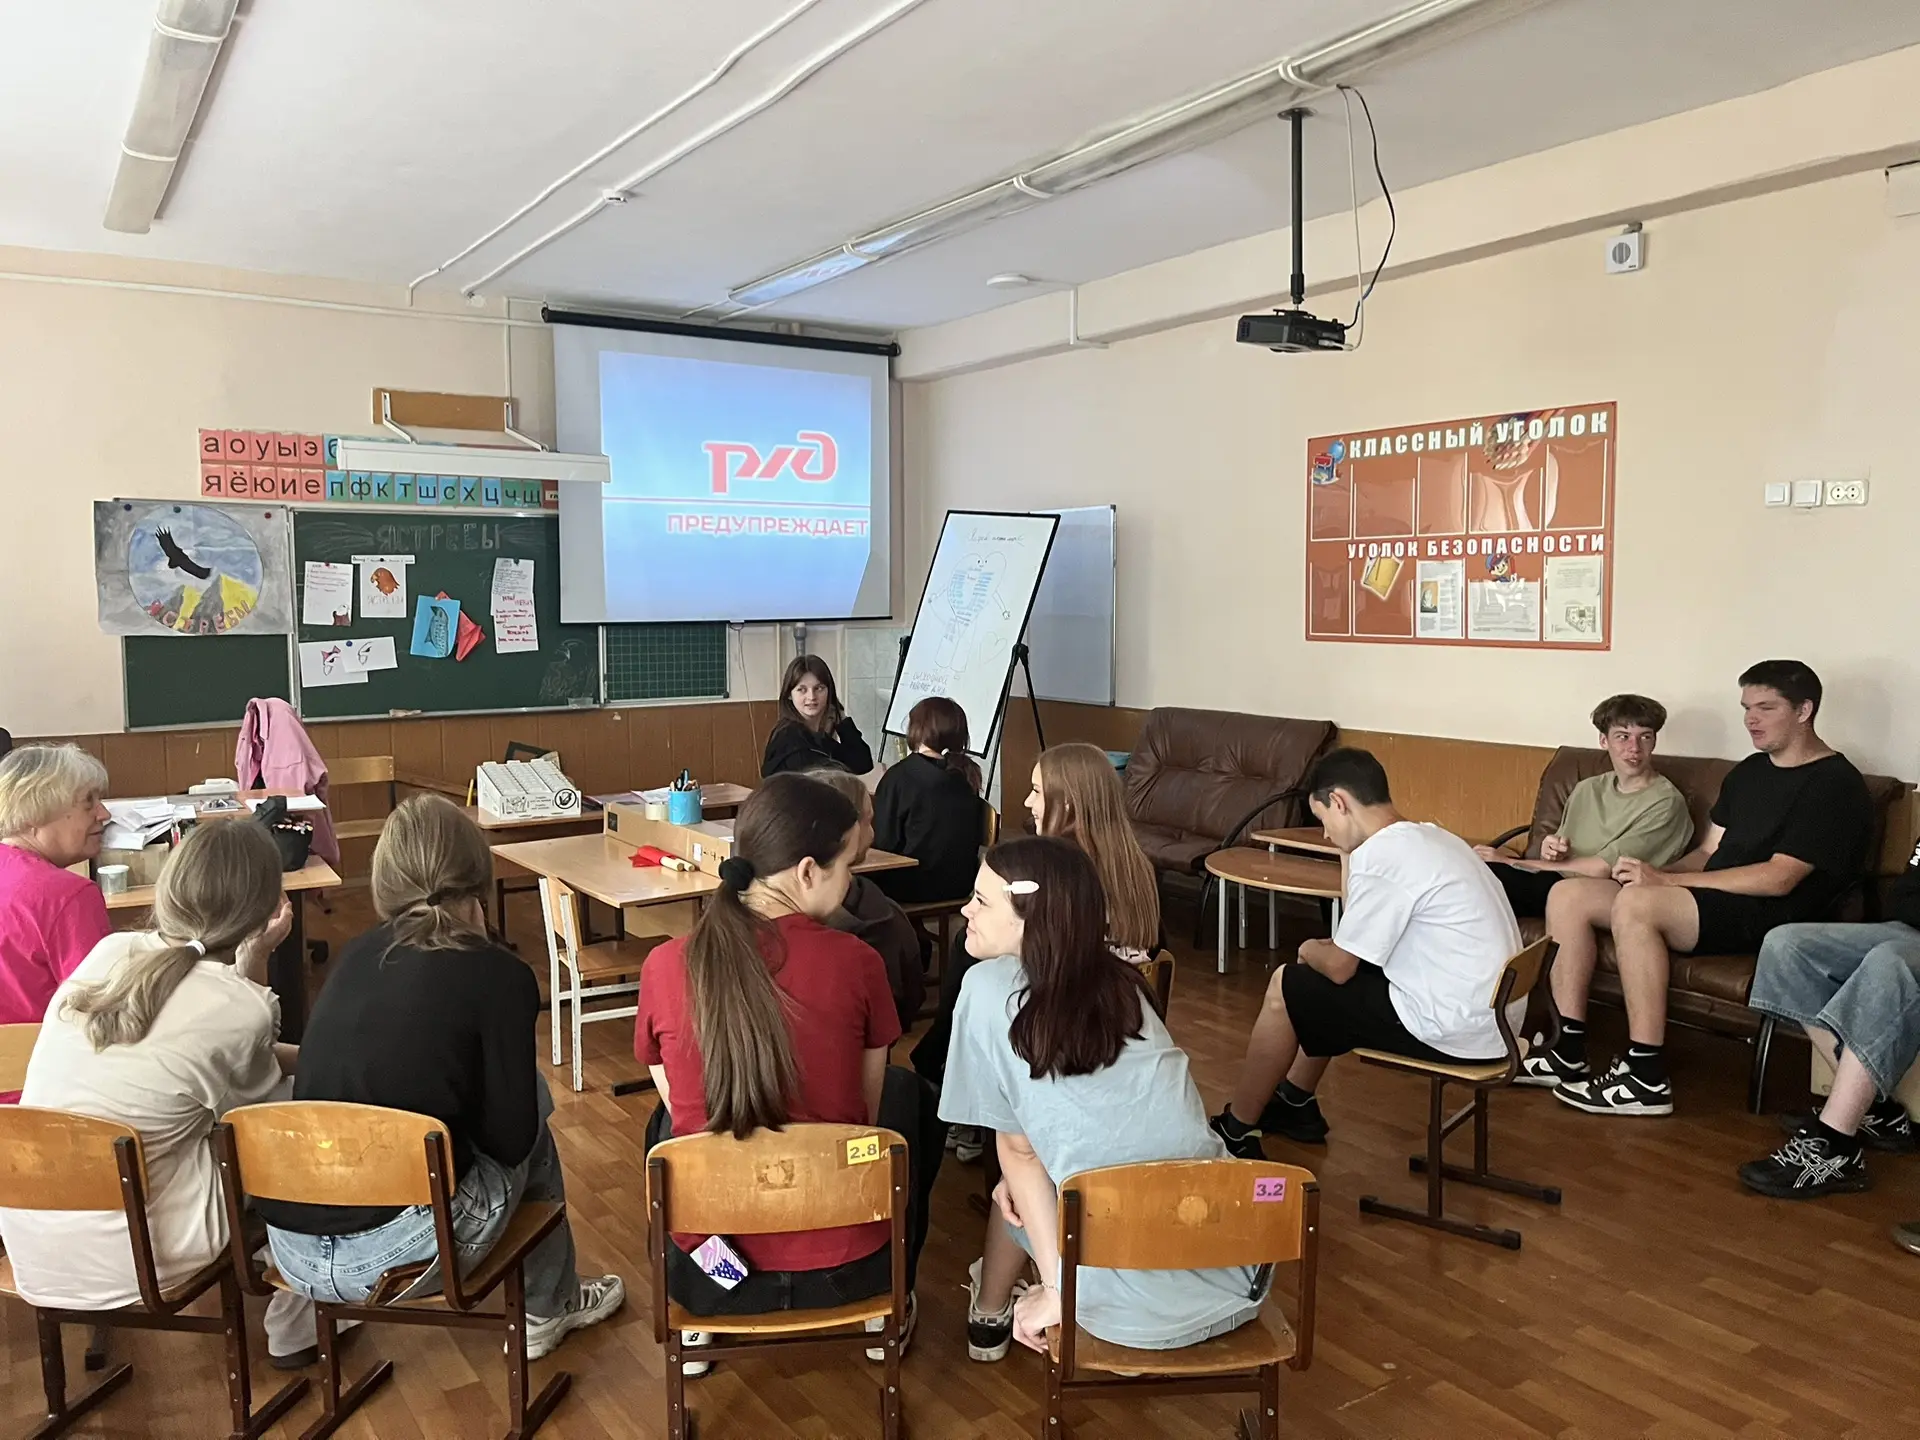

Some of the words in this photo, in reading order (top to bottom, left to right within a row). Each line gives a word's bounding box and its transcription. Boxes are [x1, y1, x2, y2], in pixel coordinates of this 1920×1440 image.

[1350, 422, 1483, 458] КЛАССНЫЙ
[1496, 411, 1608, 443] УГОЛОК
[668, 514, 868, 537] ПРЕДУПРЕЖДАЕТ
[1348, 542, 1418, 559] УГОЛОК
[1428, 534, 1605, 556] БЕЗОПАСНОСТИ
[850, 1143, 877, 1159] 2.8
[1256, 1183, 1284, 1196] 3.2
